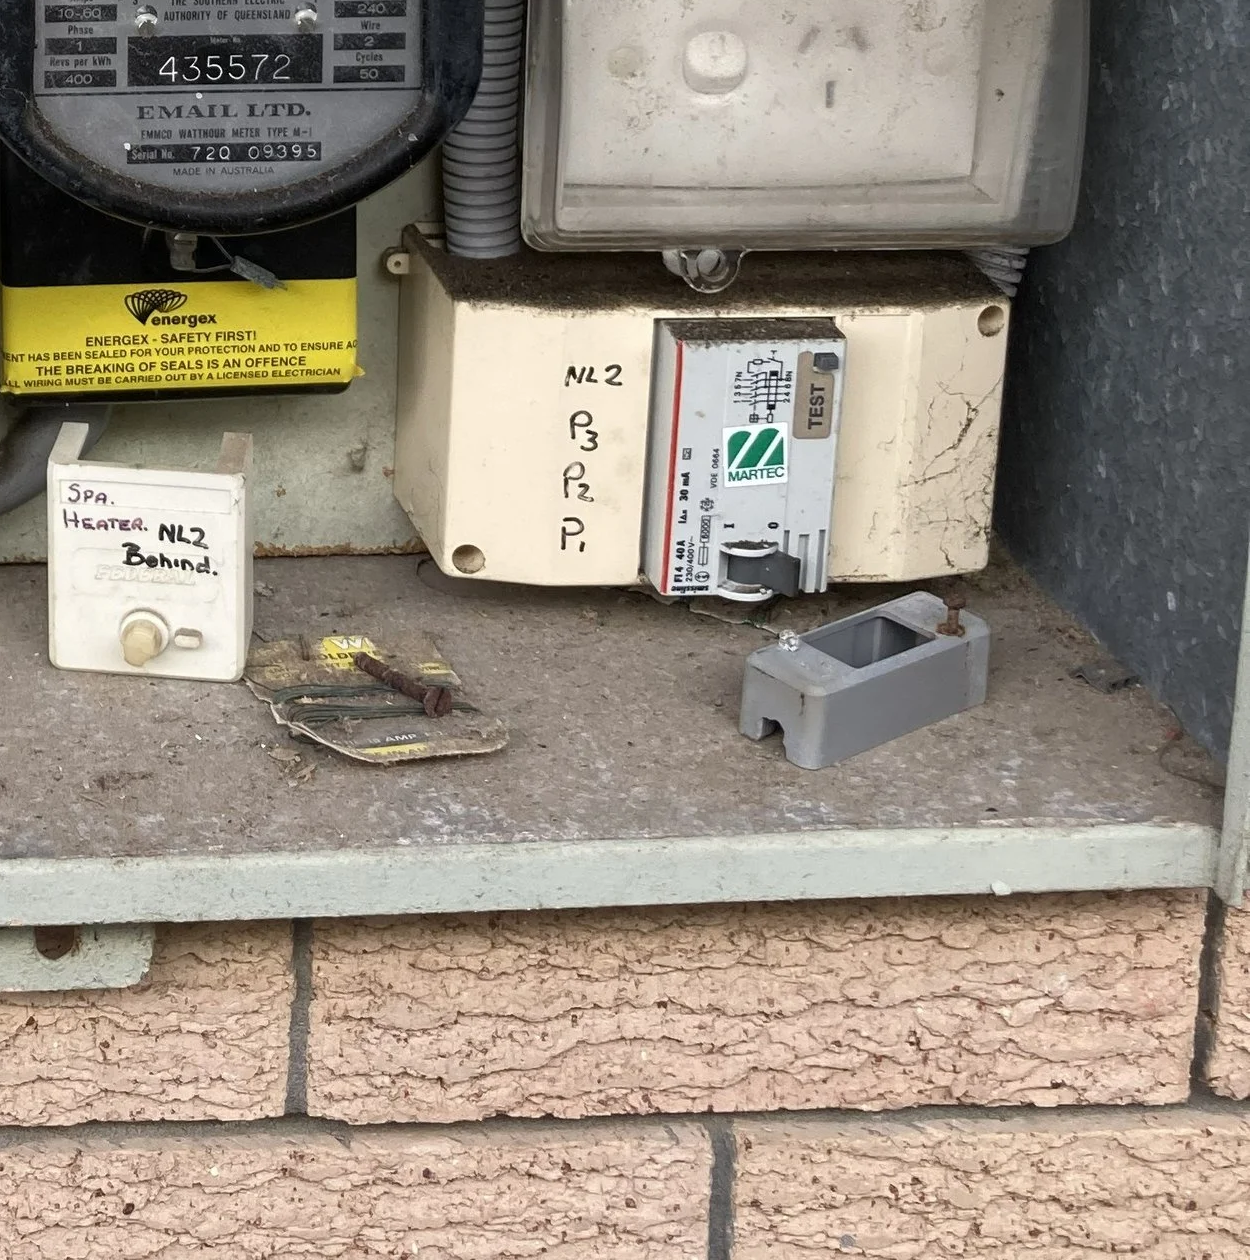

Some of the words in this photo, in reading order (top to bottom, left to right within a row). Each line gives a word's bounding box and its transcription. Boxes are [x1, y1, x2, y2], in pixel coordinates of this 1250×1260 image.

[164, 10, 211, 21] AUTHORITY
[217, 10, 228, 20] OF
[234, 9, 290, 21] QUEENSLAND
[357, 3, 386, 14] 240
[67, 25, 94, 35] Phase
[360, 20, 381, 30] Wire
[364, 36, 374, 47] 2
[74, 58, 89, 68] per
[92, 56, 112, 66] kWh
[355, 51, 383, 64] Cycles
[158, 53, 292, 82] 435572
[359, 68, 378, 79] 50
[65, 74, 93, 85] 400
[136, 104, 238, 120] EMAIL
[246, 103, 311, 118] LTD.
[141, 129, 172, 140] EMMCO
[178, 128, 225, 139] WATTHOUR
[231, 127, 261, 138] METER
[267, 127, 288, 138] TYPE
[132, 150, 157, 160] Serial
[247, 143, 317, 160] 09395
[173, 167, 201, 176] MADE
[206, 167, 216, 175] IN
[221, 166, 274, 175] AUSTRALIA
[151, 312, 217, 328] energex
[85, 334, 149, 347] ENERGEX
[160, 332, 212, 344] SAFETY
[215, 330, 257, 341] FIRST!
[28, 352, 50, 362] HAS
[53, 351, 82, 360] BEEN
[85, 349, 127, 359] SEALED
[130, 348, 152, 357] FOR
[155, 346, 185, 356] YOUR
[187, 344, 256, 355] PROTECTION
[258, 343, 280, 352] AND
[284, 343, 298, 352] TO
[300, 341, 344, 351] ENSURE
[36, 365, 62, 376] THE
[65, 363, 135, 375] BREAKING
[138, 361, 156, 372] OF
[160, 360, 203, 371] SEALS
[206, 359, 219, 369] IS
[222, 358, 241, 368] AN
[245, 356, 307, 367] OFFENCE
[23, 378, 62, 388] WIRING
[65, 377, 94, 386] MUST
[97, 376, 112, 385] BE
[114, 374, 162, 384] CARRIED
[165, 373, 186, 382] OUT
[189, 372, 204, 381] BY
[206, 372, 213, 380] A
[216, 370, 269, 380] LICENSED
[271, 368, 341, 378] ELECTRICIAN
[807, 383, 825, 430] TEST
[728, 466, 785, 482] MARTEC
[63, 508, 148, 531] HEATER.
[158, 523, 209, 549] NL2
[122, 542, 218, 576] Behind.
